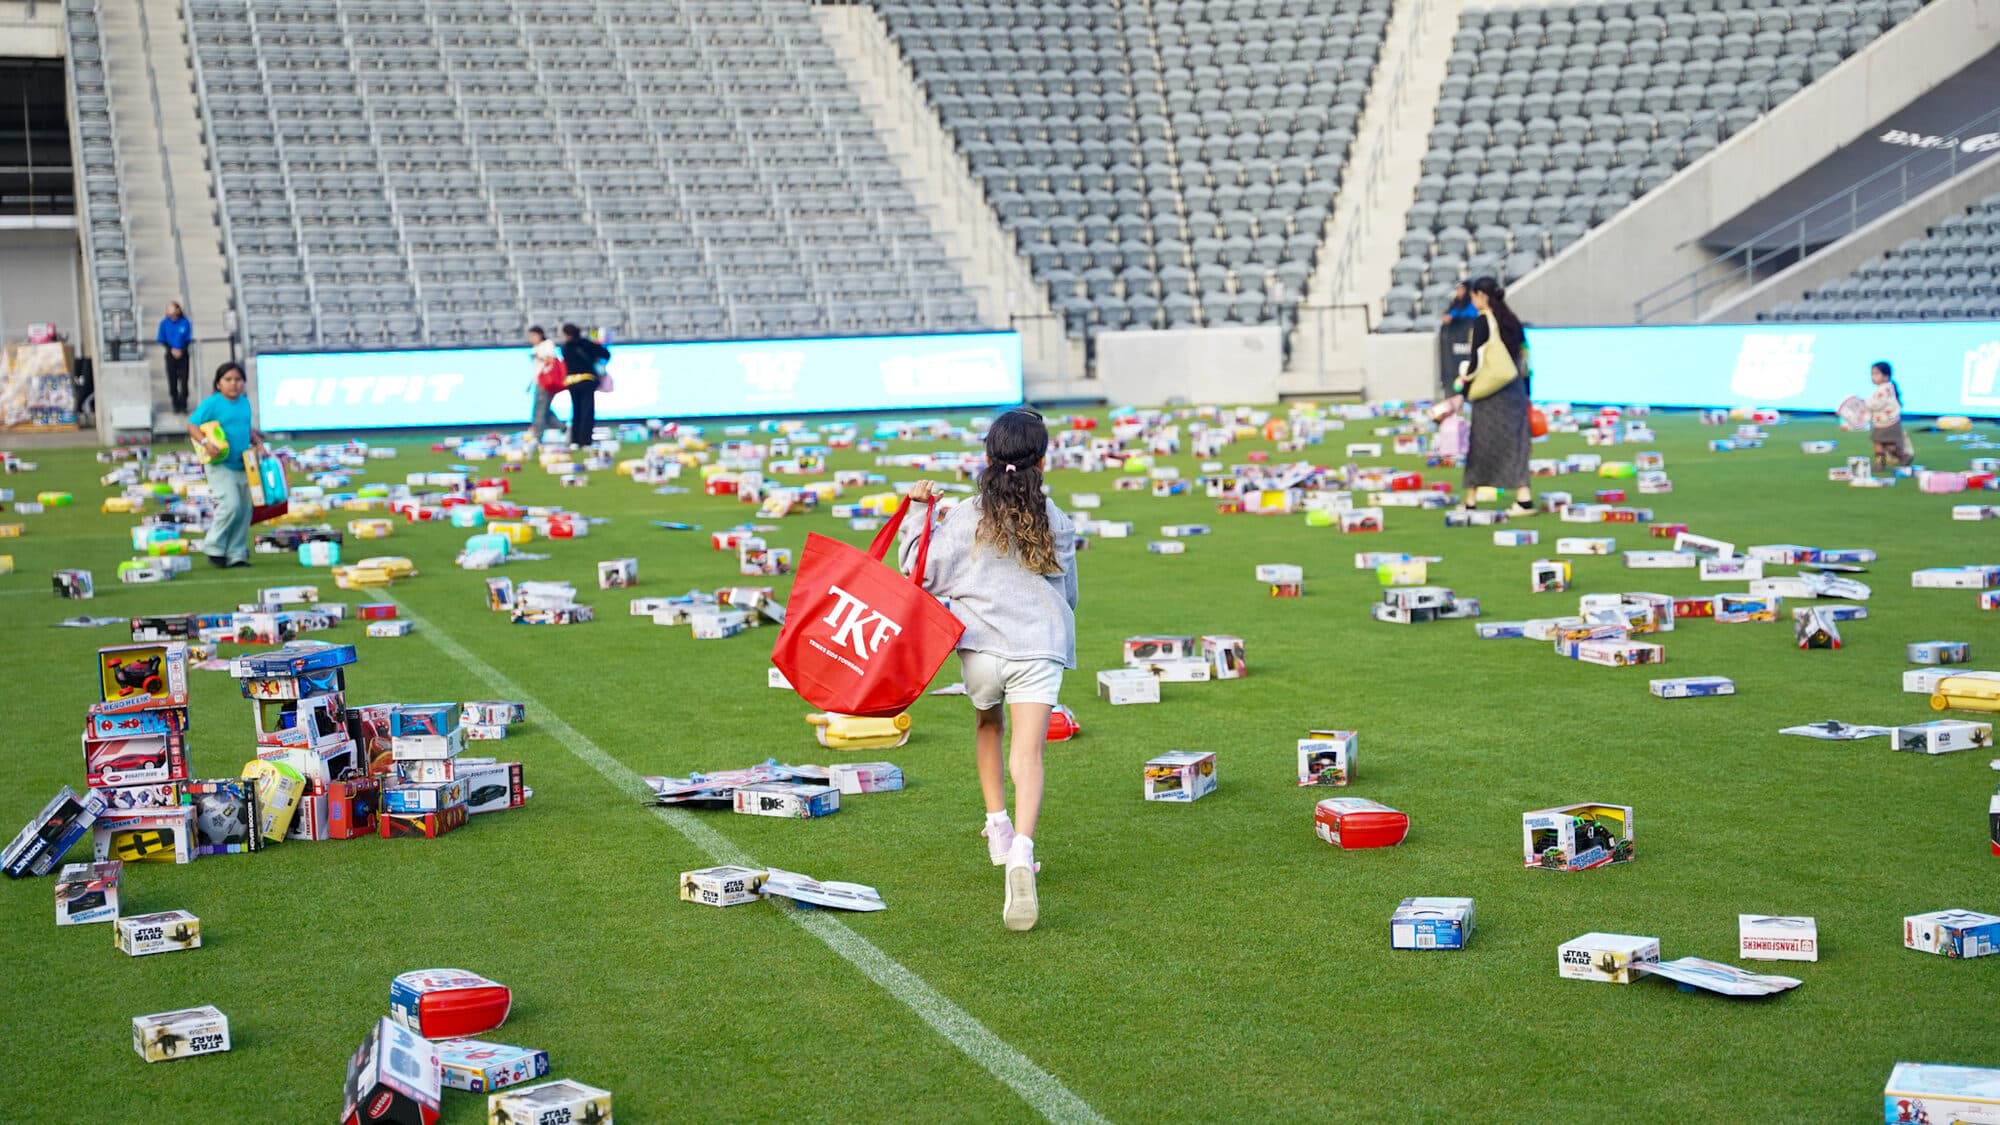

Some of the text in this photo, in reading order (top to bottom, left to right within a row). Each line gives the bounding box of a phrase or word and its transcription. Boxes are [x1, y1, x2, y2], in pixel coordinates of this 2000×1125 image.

[822, 584, 903, 660] TKF
[12, 837, 48, 874] HORNET
[724, 880, 745, 889] STAR
[724, 886, 745, 894] WARS
[134, 926, 163, 936] STAR
[135, 933, 163, 942] WARS
[1742, 940, 1800, 952] TRANSFORMERS
[1563, 950, 1592, 959] STAR
[1563, 956, 1592, 965] WARS
[189, 1033, 223, 1045] WARS
[189, 1041, 224, 1052] STAR
[539, 1107, 571, 1121] STAR
